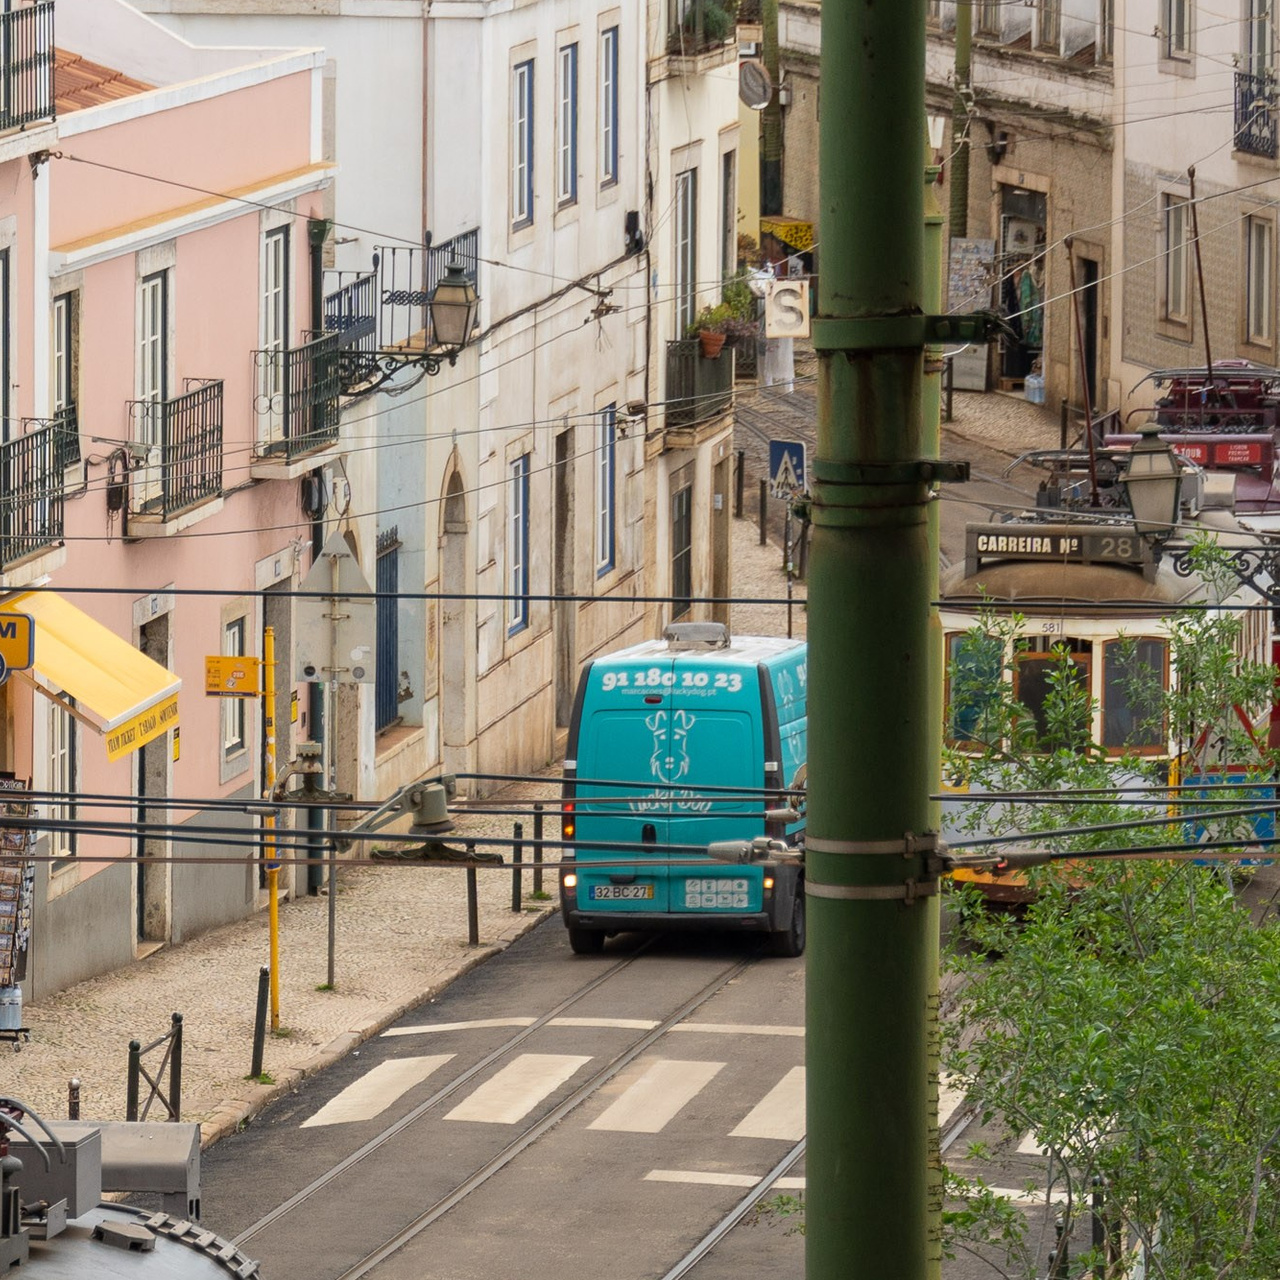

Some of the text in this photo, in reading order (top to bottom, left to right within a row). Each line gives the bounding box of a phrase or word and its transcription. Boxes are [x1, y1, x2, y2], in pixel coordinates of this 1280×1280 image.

[773, 287, 804, 331] S
[1180, 447, 1202, 459] TOUR
[977, 535, 1052, 554] CARREIRA
[1100, 537, 1133, 558] 28
[1041, 622, 1060, 634] 581
[602, 667, 742, 692] 91 180 10 23
